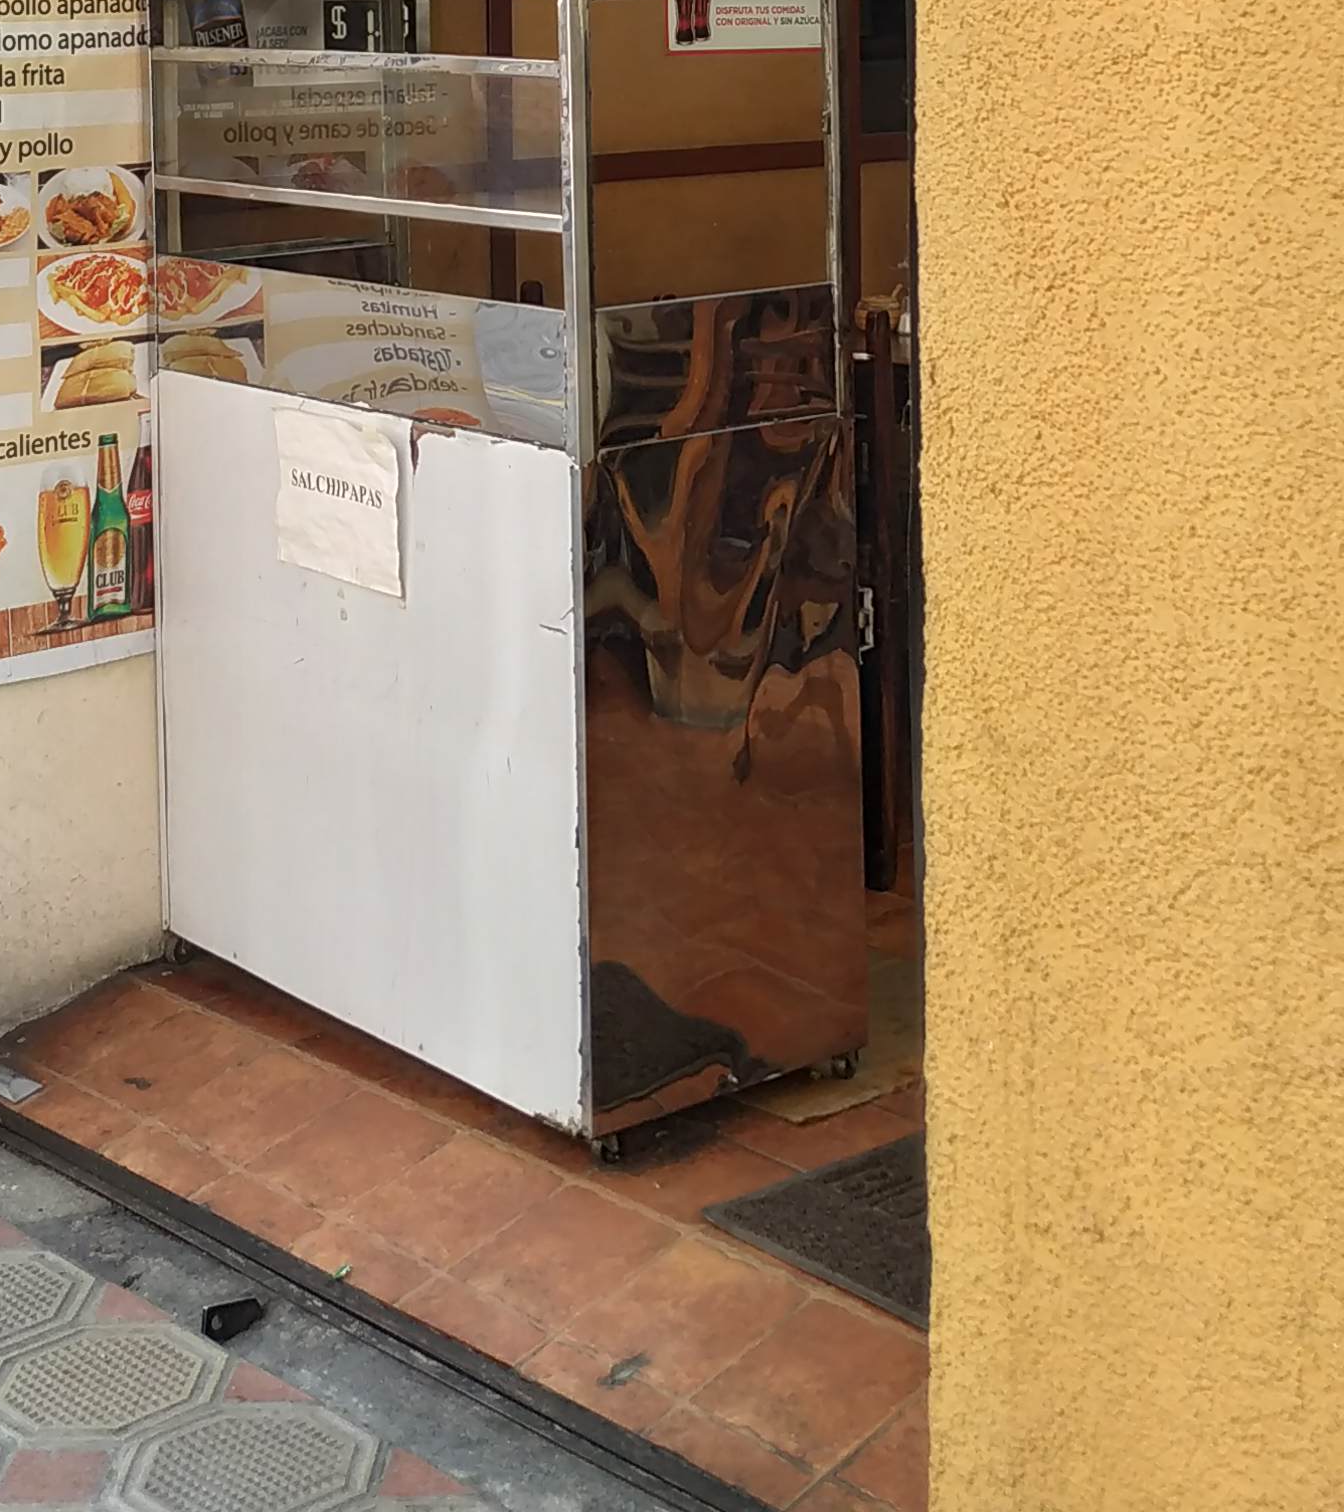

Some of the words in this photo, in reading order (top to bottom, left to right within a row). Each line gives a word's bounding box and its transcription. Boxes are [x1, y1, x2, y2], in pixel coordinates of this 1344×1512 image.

[716, 5, 753, 15] DISFRUTA
[756, 5, 769, 14] TUS
[771, 5, 805, 14] COMIDAS
[716, 17, 732, 26] CON
[735, 17, 772, 26] ORIGINAL
[773, 17, 778, 25] Y
[780, 17, 792, 25] SIN
[795, 14, 819, 25] AZÚCA
[195, 22, 243, 47] PILSENER
[22, 63, 65, 86] frita
[0, 140, 15, 165] y
[18, 133, 73, 163] pollo
[291, 468, 383, 509] SALCHIPAPAS
[96, 570, 124, 589] CLUB
